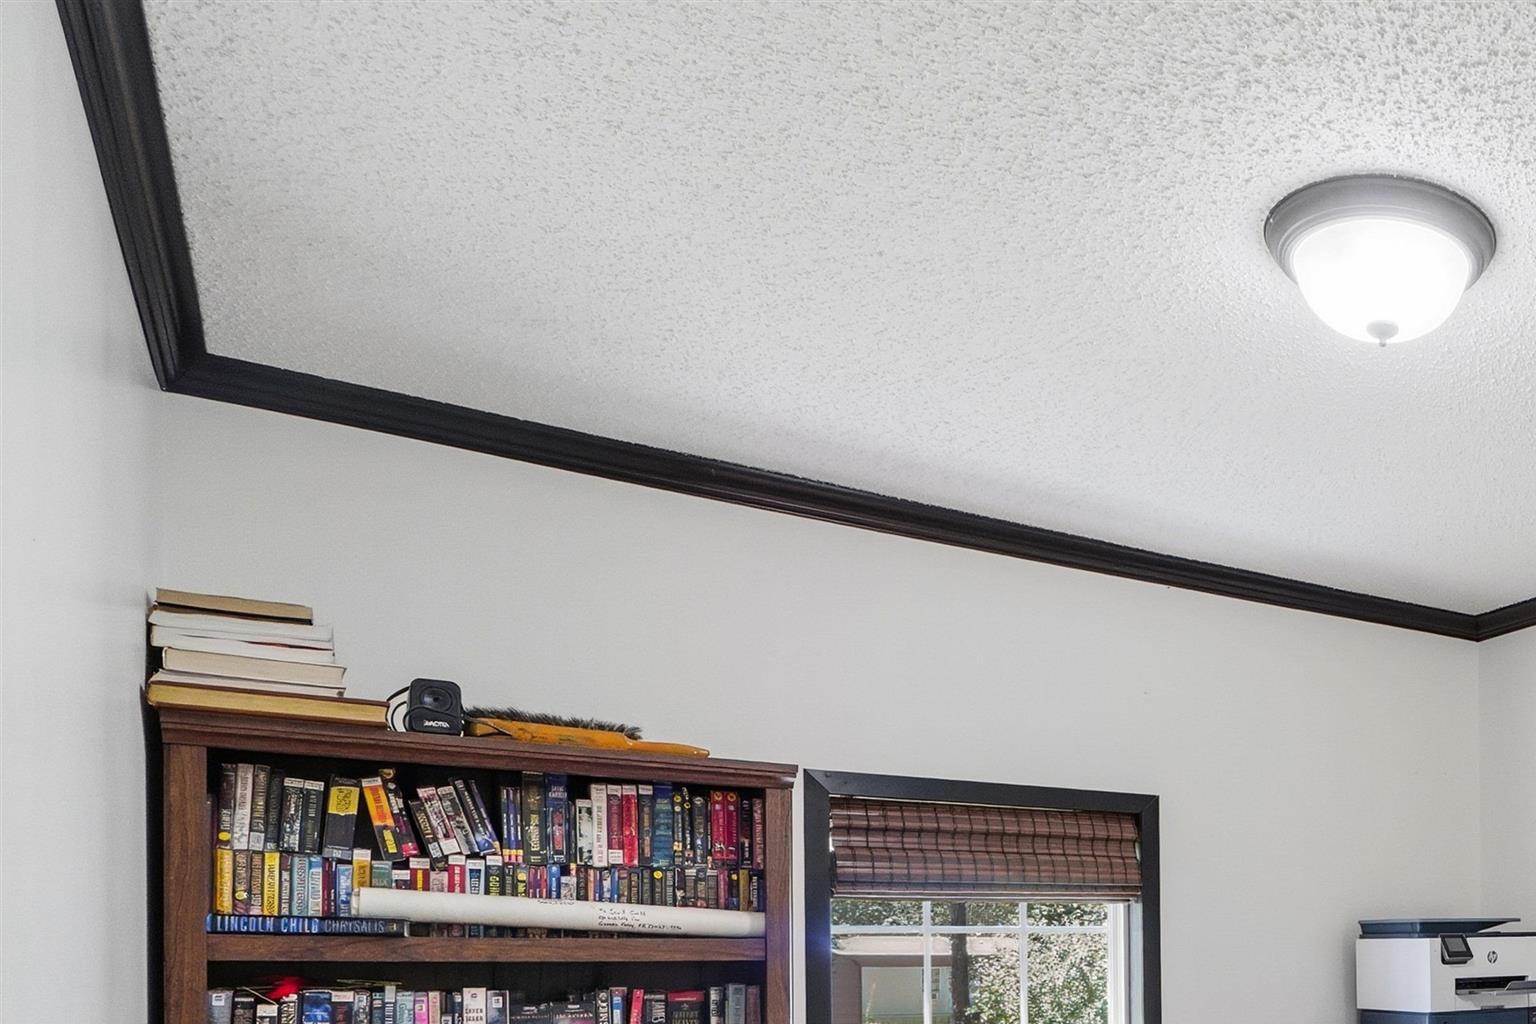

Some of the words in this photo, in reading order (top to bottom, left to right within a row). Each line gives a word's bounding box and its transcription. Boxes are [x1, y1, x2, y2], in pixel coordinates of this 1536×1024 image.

[216, 914, 275, 933] LINCOLN
[280, 916, 320, 933] CHILD
[324, 918, 385, 934] CHRYSALIS
